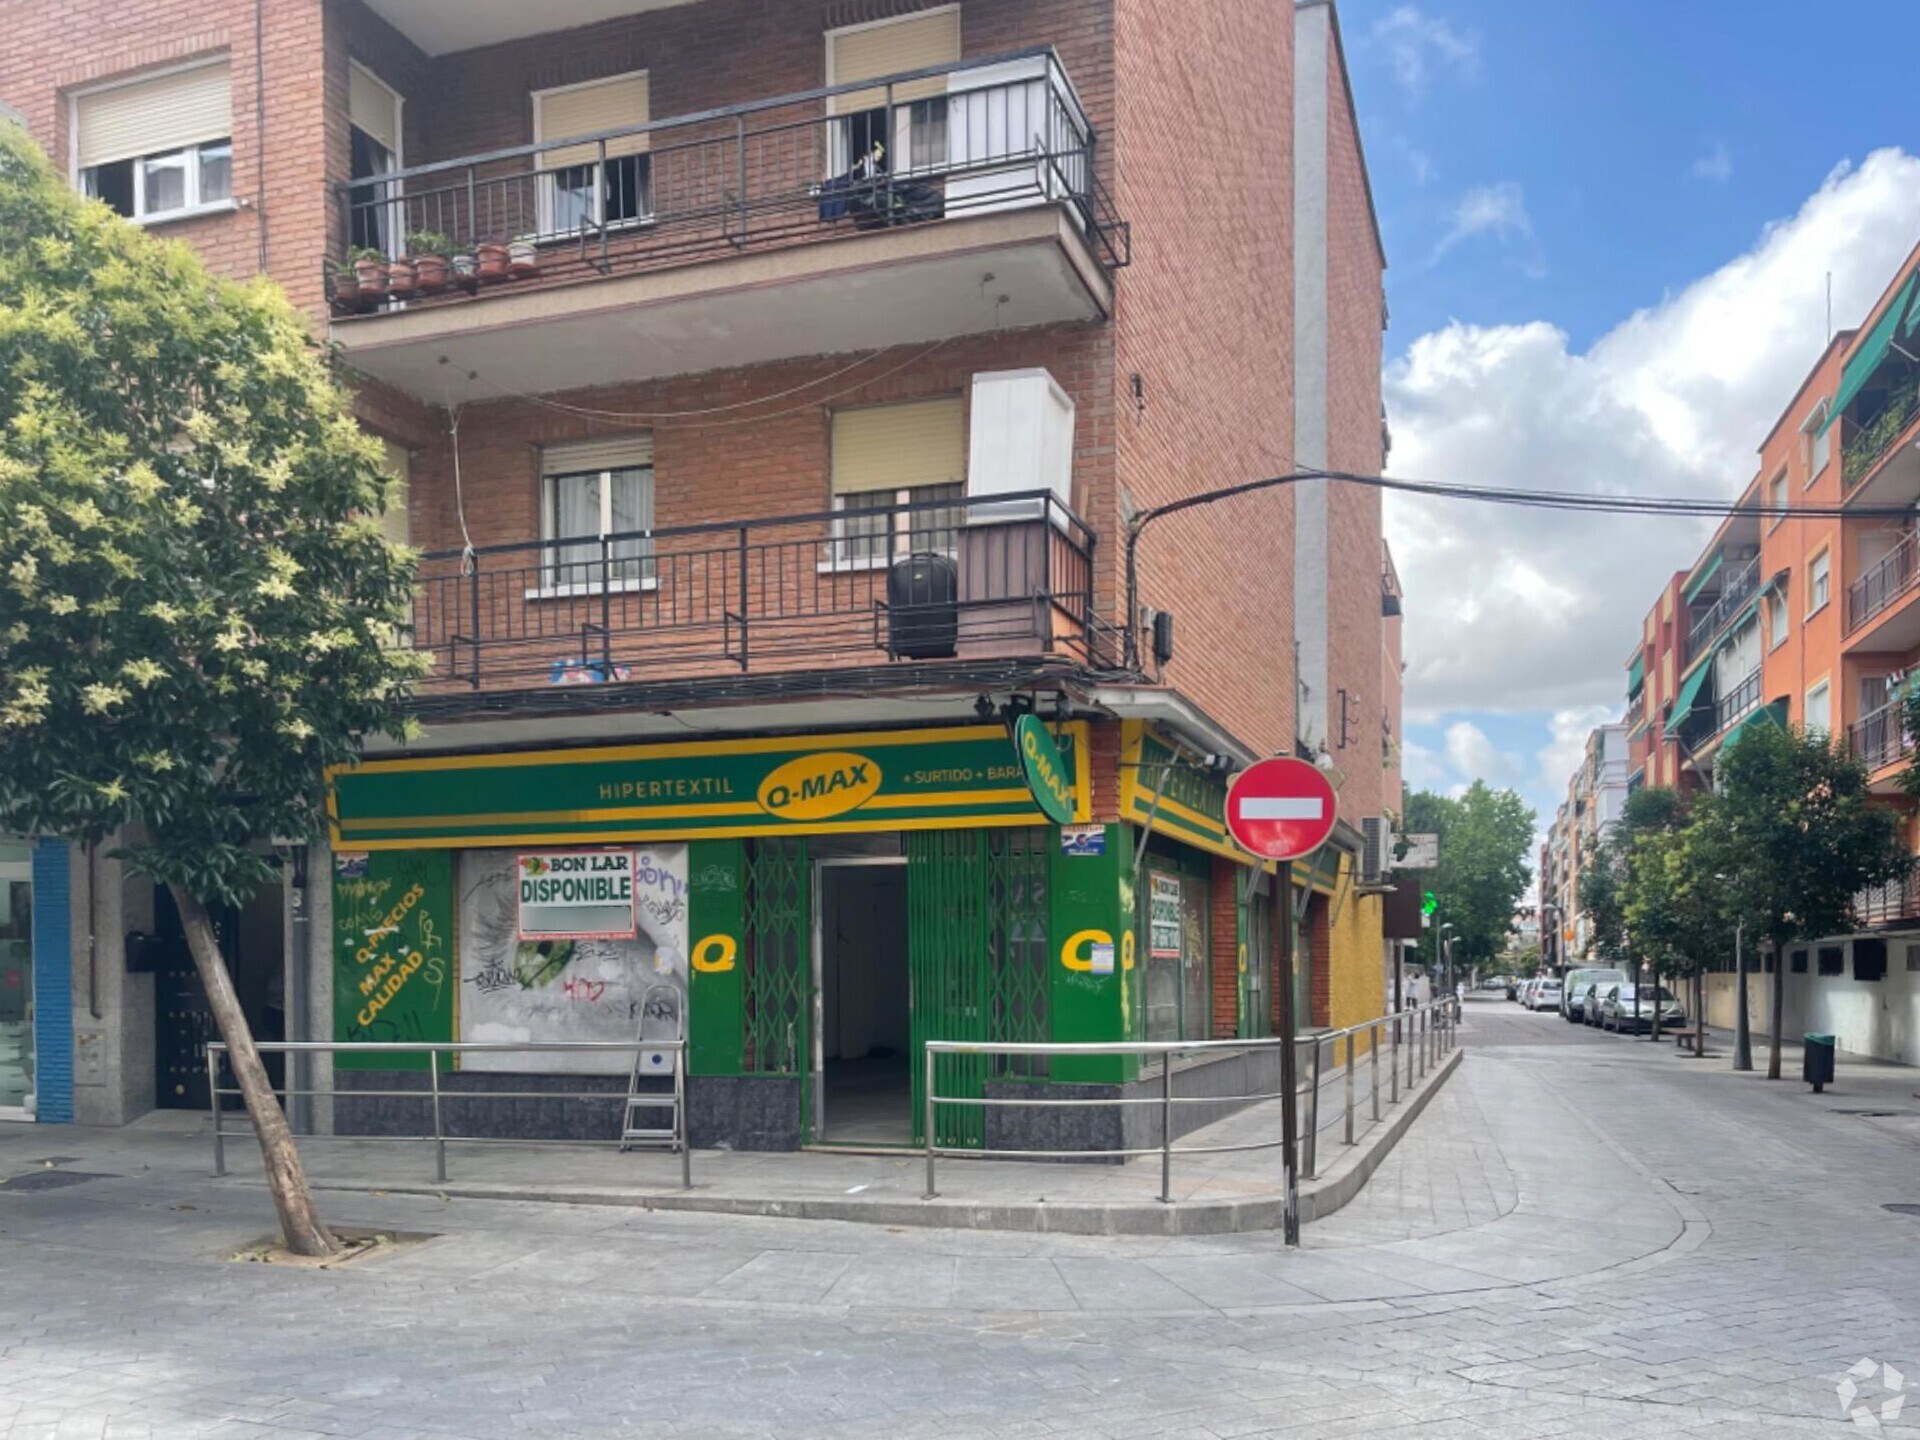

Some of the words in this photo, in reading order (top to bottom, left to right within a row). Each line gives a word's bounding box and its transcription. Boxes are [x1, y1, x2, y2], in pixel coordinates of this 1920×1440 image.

[599, 777, 734, 799] HIPERTEXTIL
[766, 762, 869, 809] Q-MAX
[914, 768, 973, 785] SURTIDO
[1024, 731, 1070, 811] Q-MAX
[551, 857, 587, 872] BON
[590, 855, 628, 871] LAR
[521, 876, 631, 904] DISPONIBLE
[357, 951, 423, 1026] CALIDAD
[359, 953, 396, 996] MAX
